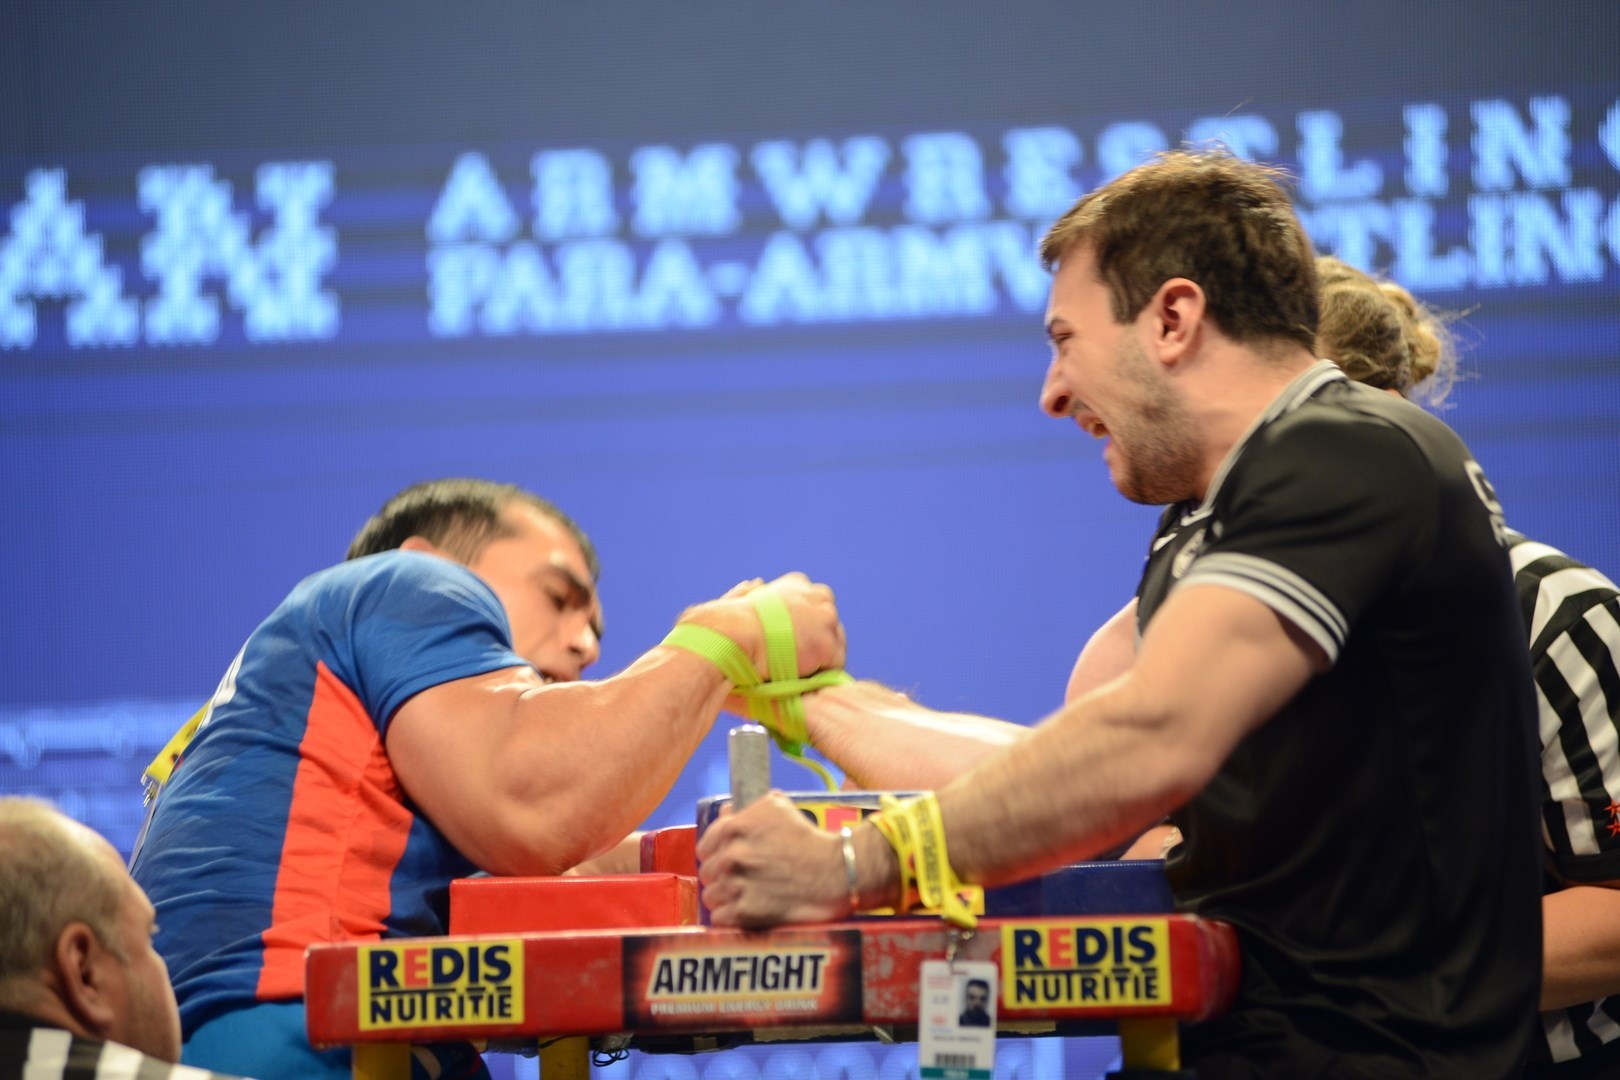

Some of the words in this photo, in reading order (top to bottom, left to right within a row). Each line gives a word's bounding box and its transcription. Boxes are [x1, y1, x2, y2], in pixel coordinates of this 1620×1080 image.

[369, 945, 512, 989] REDIS
[1014, 926, 1156, 968] REDIS
[653, 954, 824, 994] ARMFIGHT
[1015, 970, 1159, 1003] NUTRITIE
[370, 990, 512, 1024] NUTRITIE
